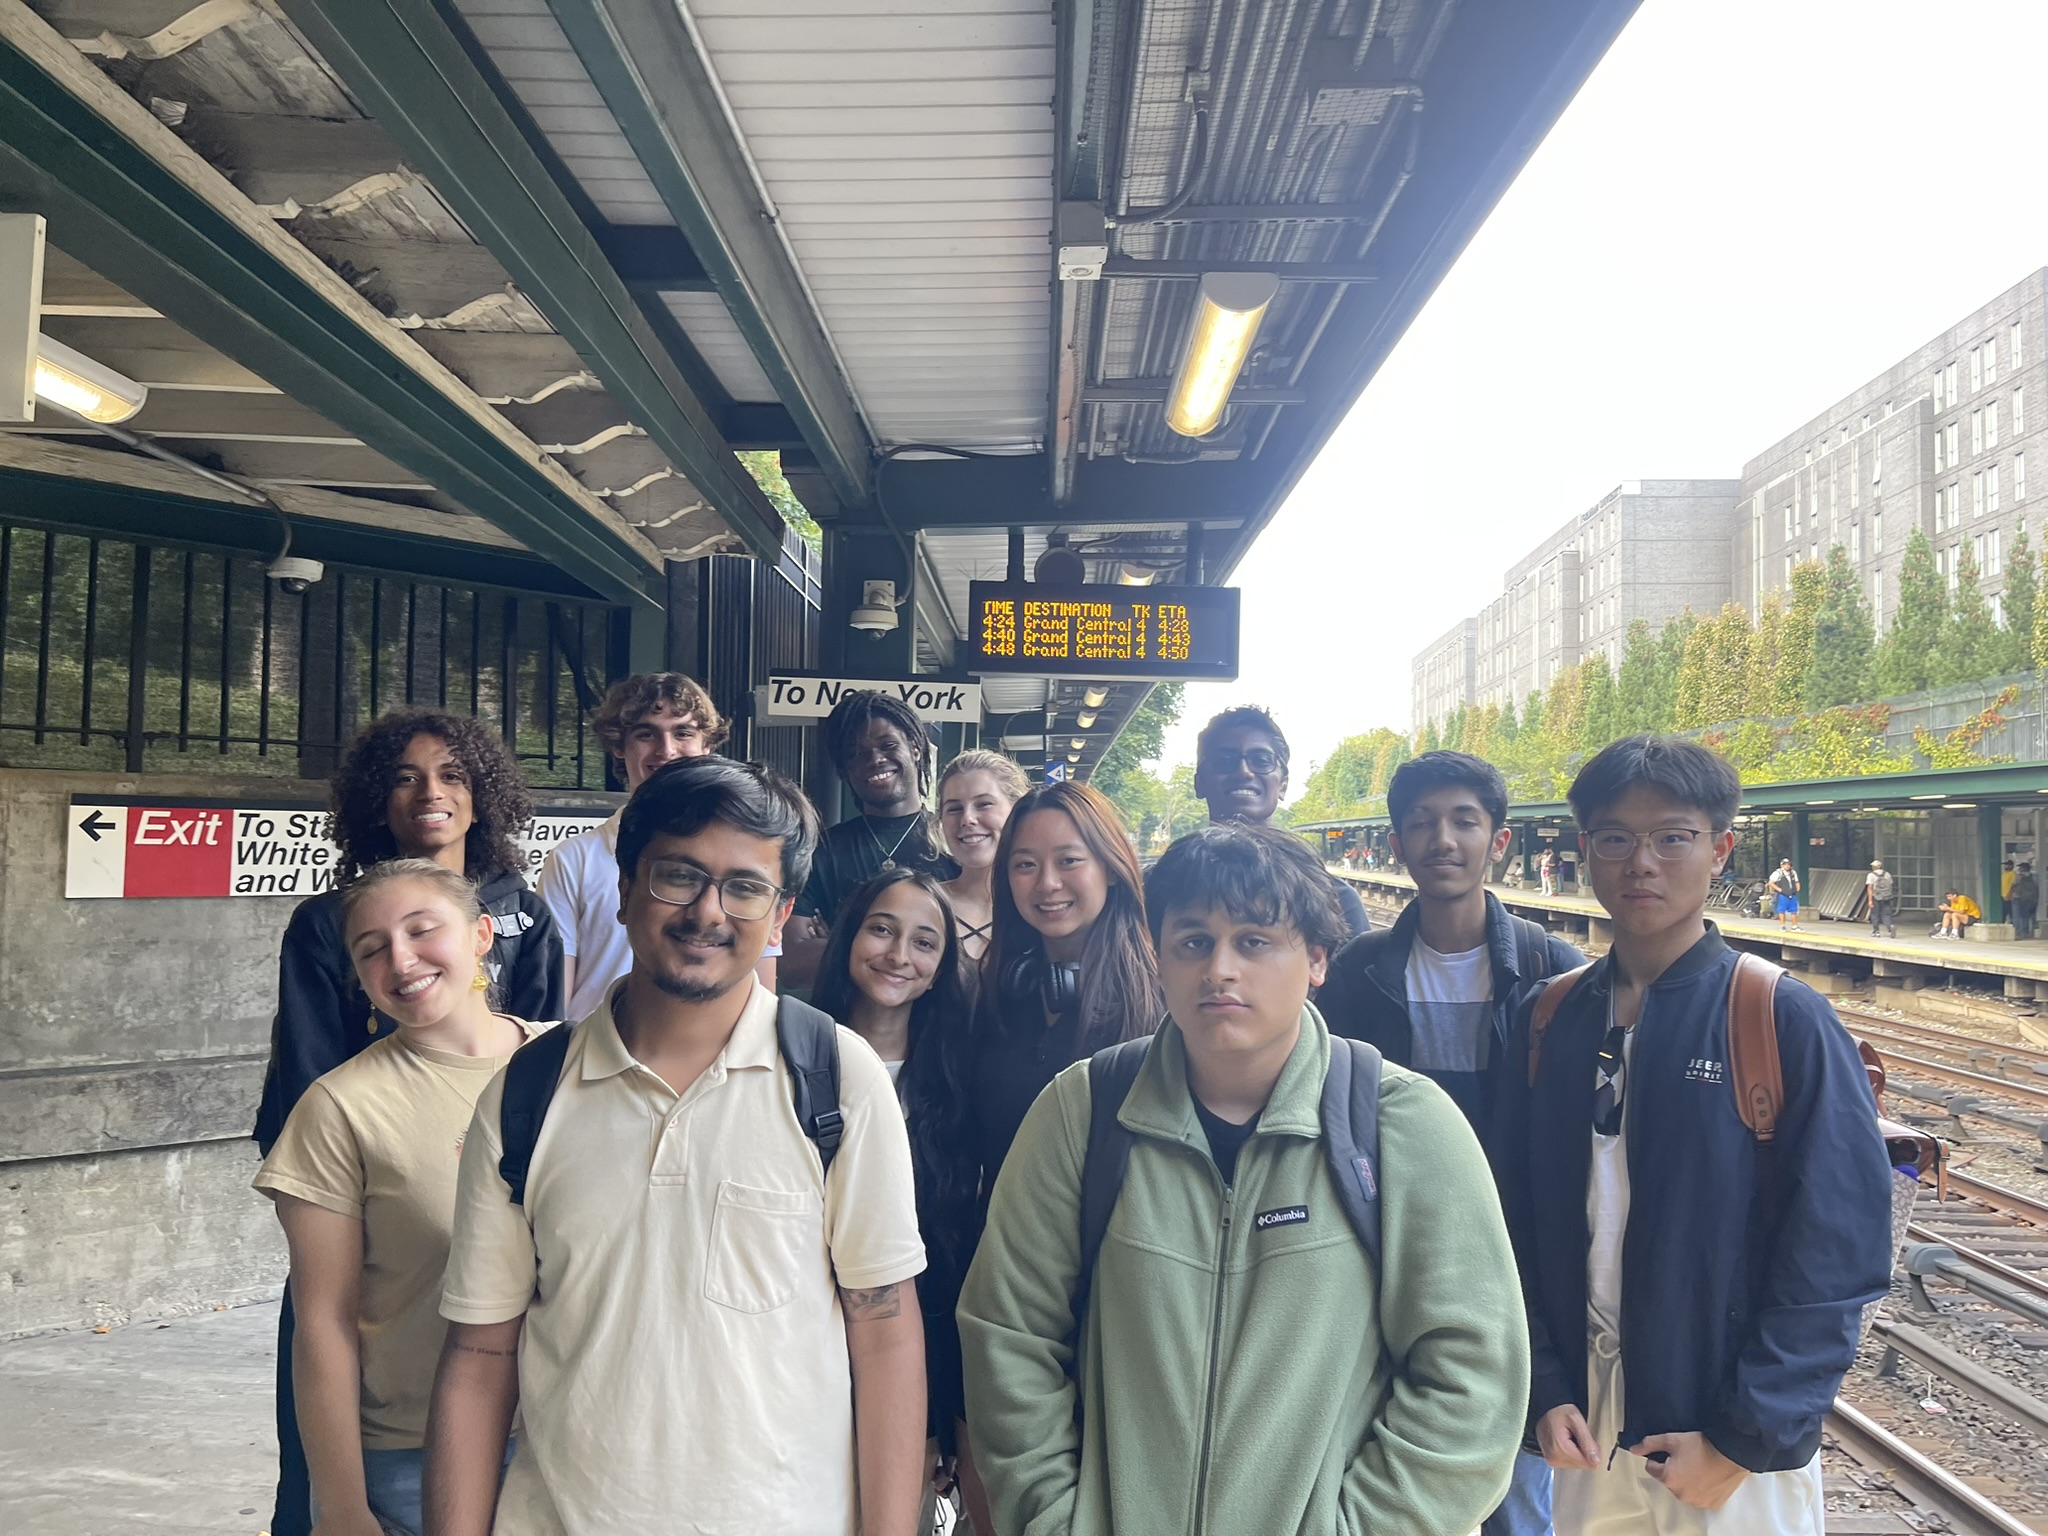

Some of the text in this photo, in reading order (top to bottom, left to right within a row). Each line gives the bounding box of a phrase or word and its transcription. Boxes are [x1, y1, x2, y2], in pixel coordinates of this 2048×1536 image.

[983, 601, 1186, 618] TIME DESTINATION TK ETA
[983, 615, 1189, 631] 4:24 Grand Central 4 4:28
[983, 629, 1190, 646] 4:40 Grand Central 4 4:43
[983, 643, 1189, 659] 4:48 Grand Central 4 4:50
[771, 679, 966, 710] To Ne York
[1055, 769, 1062, 779] 4
[133, 810, 222, 846] Exit
[239, 813, 275, 838] To
[237, 841, 329, 866] White
[235, 868, 301, 892] and
[1265, 1210, 1306, 1224] Columbia
